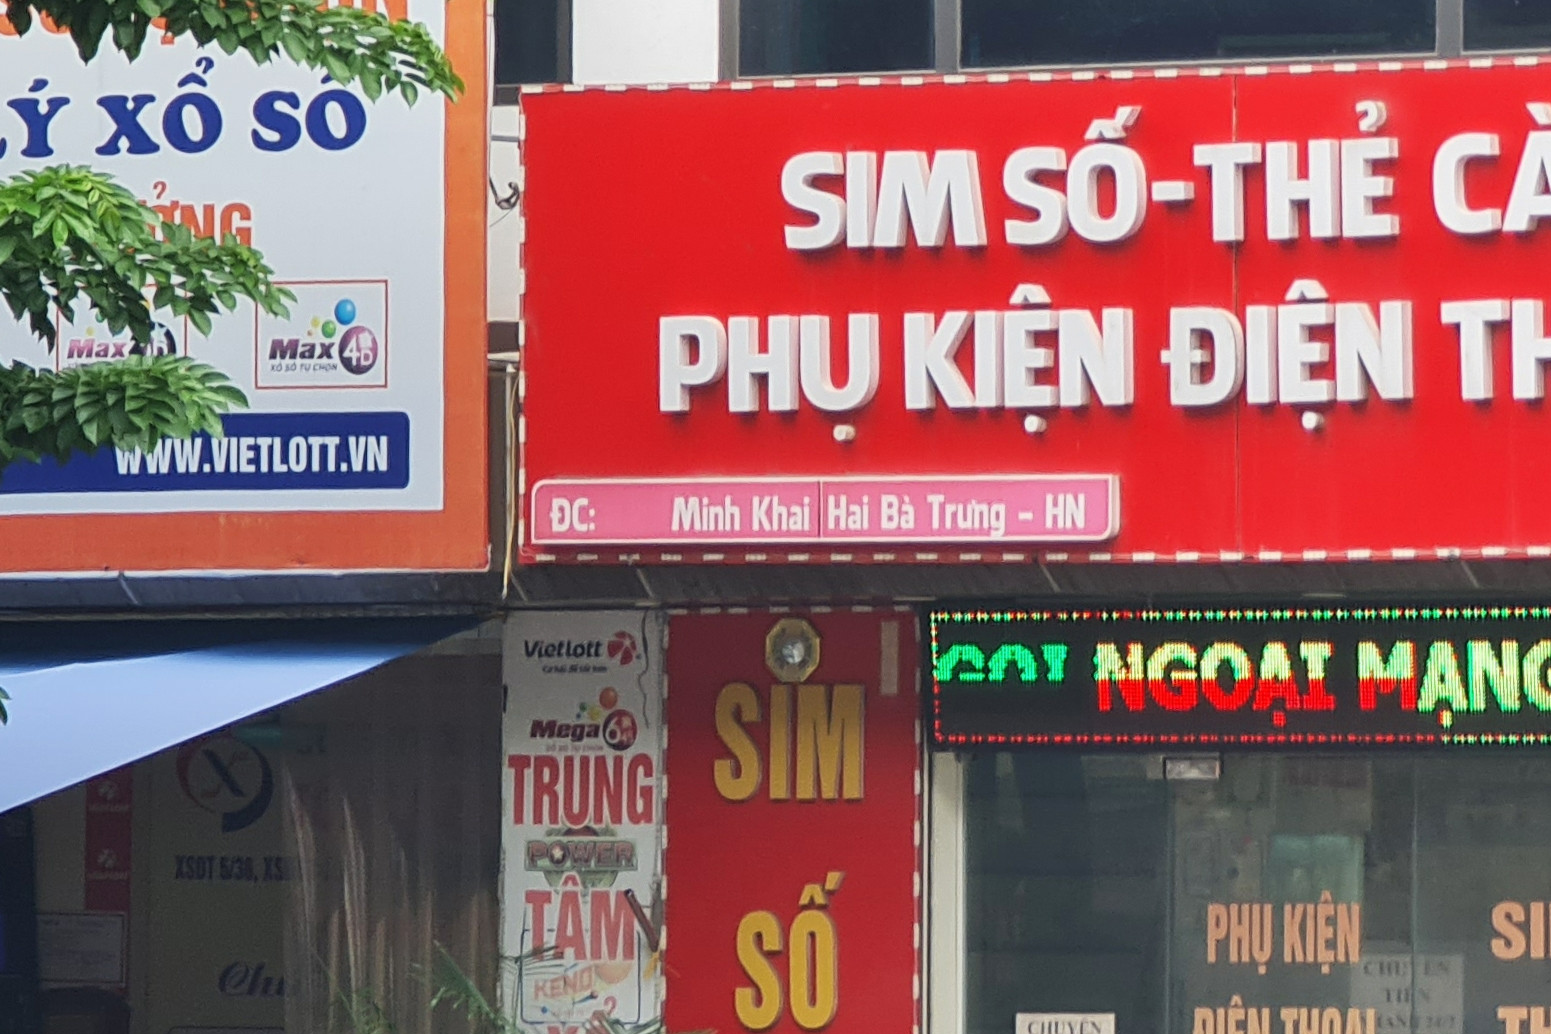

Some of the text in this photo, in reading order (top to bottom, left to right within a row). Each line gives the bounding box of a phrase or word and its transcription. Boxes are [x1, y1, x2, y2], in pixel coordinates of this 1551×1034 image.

[0, 78, 70, 158] Ý
[95, 57, 223, 154] XỔ
[780, 149, 987, 250] SIM
[268, 339, 335, 360] Max
[659, 313, 880, 441] PHỤ
[904, 283, 1134, 434] KIỆN
[1160, 279, 1413, 431] ĐIỆN
[115, 435, 388, 475] WWW.VIETLOTT.VN
[549, 498, 596, 532] ĐC:
[671, 495, 740, 532] Minh
[751, 495, 811, 531] Khai
[827, 494, 869, 531] Hai
[880, 494, 915, 530] Bà
[927, 493, 1006, 537] Trưng
[1044, 492, 1086, 530] HN
[523, 639, 604, 659] Vietlott
[1094, 641, 1335, 726] NGOẠI
[530, 719, 600, 742] Mega
[713, 682, 866, 801] SIM
[508, 753, 655, 826] TRUNG
[529, 841, 634, 867] POWER
[524, 873, 635, 961] TÂM
[735, 871, 845, 1031] SỐ
[1207, 889, 1361, 974] PHỤ KIỆN
